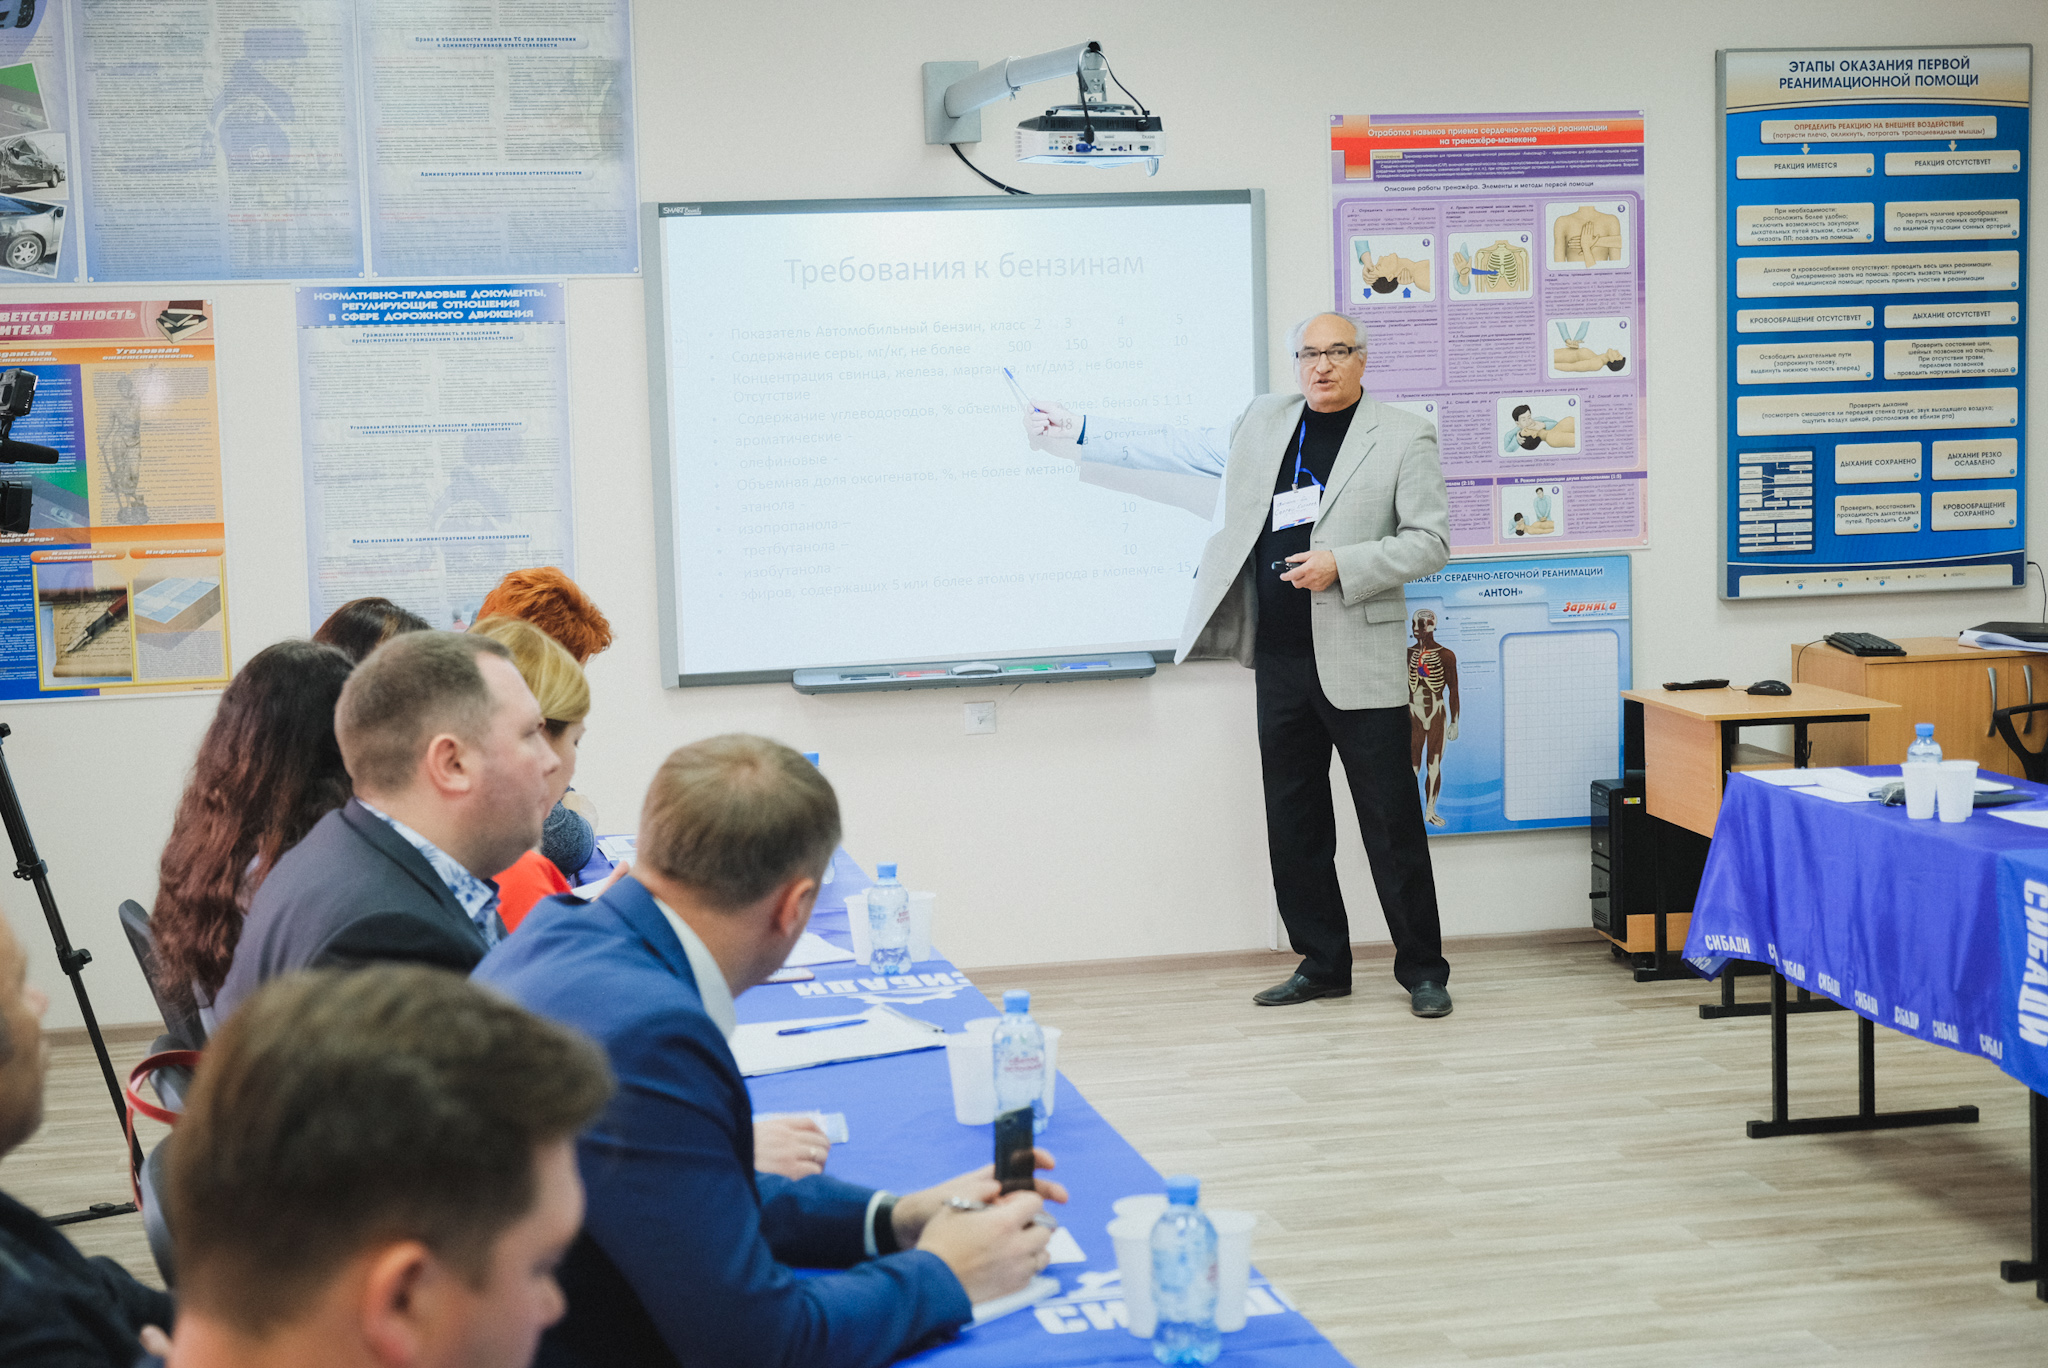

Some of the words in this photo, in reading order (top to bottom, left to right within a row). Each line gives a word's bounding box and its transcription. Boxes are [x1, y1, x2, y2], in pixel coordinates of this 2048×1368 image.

[1788, 60, 1835, 72] ЭТАПЫ
[1839, 59, 1913, 71] ОКАЗАНИЯ
[1917, 55, 1970, 70] ПЕРВОЙ
[1779, 74, 1910, 89] РЕАНИМАЦИОННОЙ
[1914, 74, 1979, 86] ПОМОЩИ
[1793, 123, 1836, 131] ОПРЕДЕЛИТЬ
[1838, 122, 1872, 130] РЕАКЦИЮ
[1917, 120, 1964, 128] ВОЗДЕЙСТВИЕ
[1367, 128, 1411, 138] Отработка
[1412, 128, 1446, 136] навыков
[1447, 128, 1479, 136] приема
[1479, 125, 1556, 135] сердечно-легочной
[1557, 125, 1608, 134] реанимации
[1451, 136, 1537, 145] тренажёре-манекене
[1773, 162, 1805, 170] РЕАКЦИЯ
[1806, 161, 1837, 169] ИМЕЕТСЯ
[1914, 159, 1945, 167] РЕАКЦИЯ
[1946, 158, 1991, 166] ОТСУТСТВУЕТ
[662, 206, 686, 214] SMART
[313, 290, 467, 300] НОРМАТИВНО-ПРАВОВЫЕ
[470, 289, 547, 299] ДОКУМЕНТЫ,
[341, 301, 438, 311] РЕГУЛИРУЮЩИЕ
[442, 299, 520, 309] ОТНОШЕНИЯ
[328, 313, 336, 321] В
[341, 312, 379, 321] СФЕРЕ
[383, 311, 464, 321] ДОРОЖНОГО
[467, 309, 534, 320] ДВИЖЕНИЯ
[1749, 316, 1814, 324] КРОВООБРАЩЕНИЕ
[1816, 314, 1861, 322] ОТСУТСТВУЕТ
[1912, 312, 1944, 320] ДЫХАНИЕ
[1946, 310, 1990, 318] ОТСУТСТВУЕТ
[115, 347, 180, 355] Уголовная
[1947, 452, 1979, 460] ДЫХАНИЕ
[1839, 459, 1872, 467] ДЫХАНИЕ
[1874, 458, 1917, 466] СОХРАНЕНО
[1953, 458, 1995, 466] ОСЛАБЛЕНО
[1942, 501, 2005, 512] КРОВООБРАЩЕНИЕ
[1953, 509, 1995, 517] СОХРАНЕНО
[1444, 570, 1539, 582] СЕРДЕЧНО-ЛЕГОЧНОЙ
[1541, 568, 1603, 577] РЕАНИМАЦИИ
[1478, 587, 1523, 597] «АНТОН»
[1705, 934, 1751, 954] СИБАДИ
